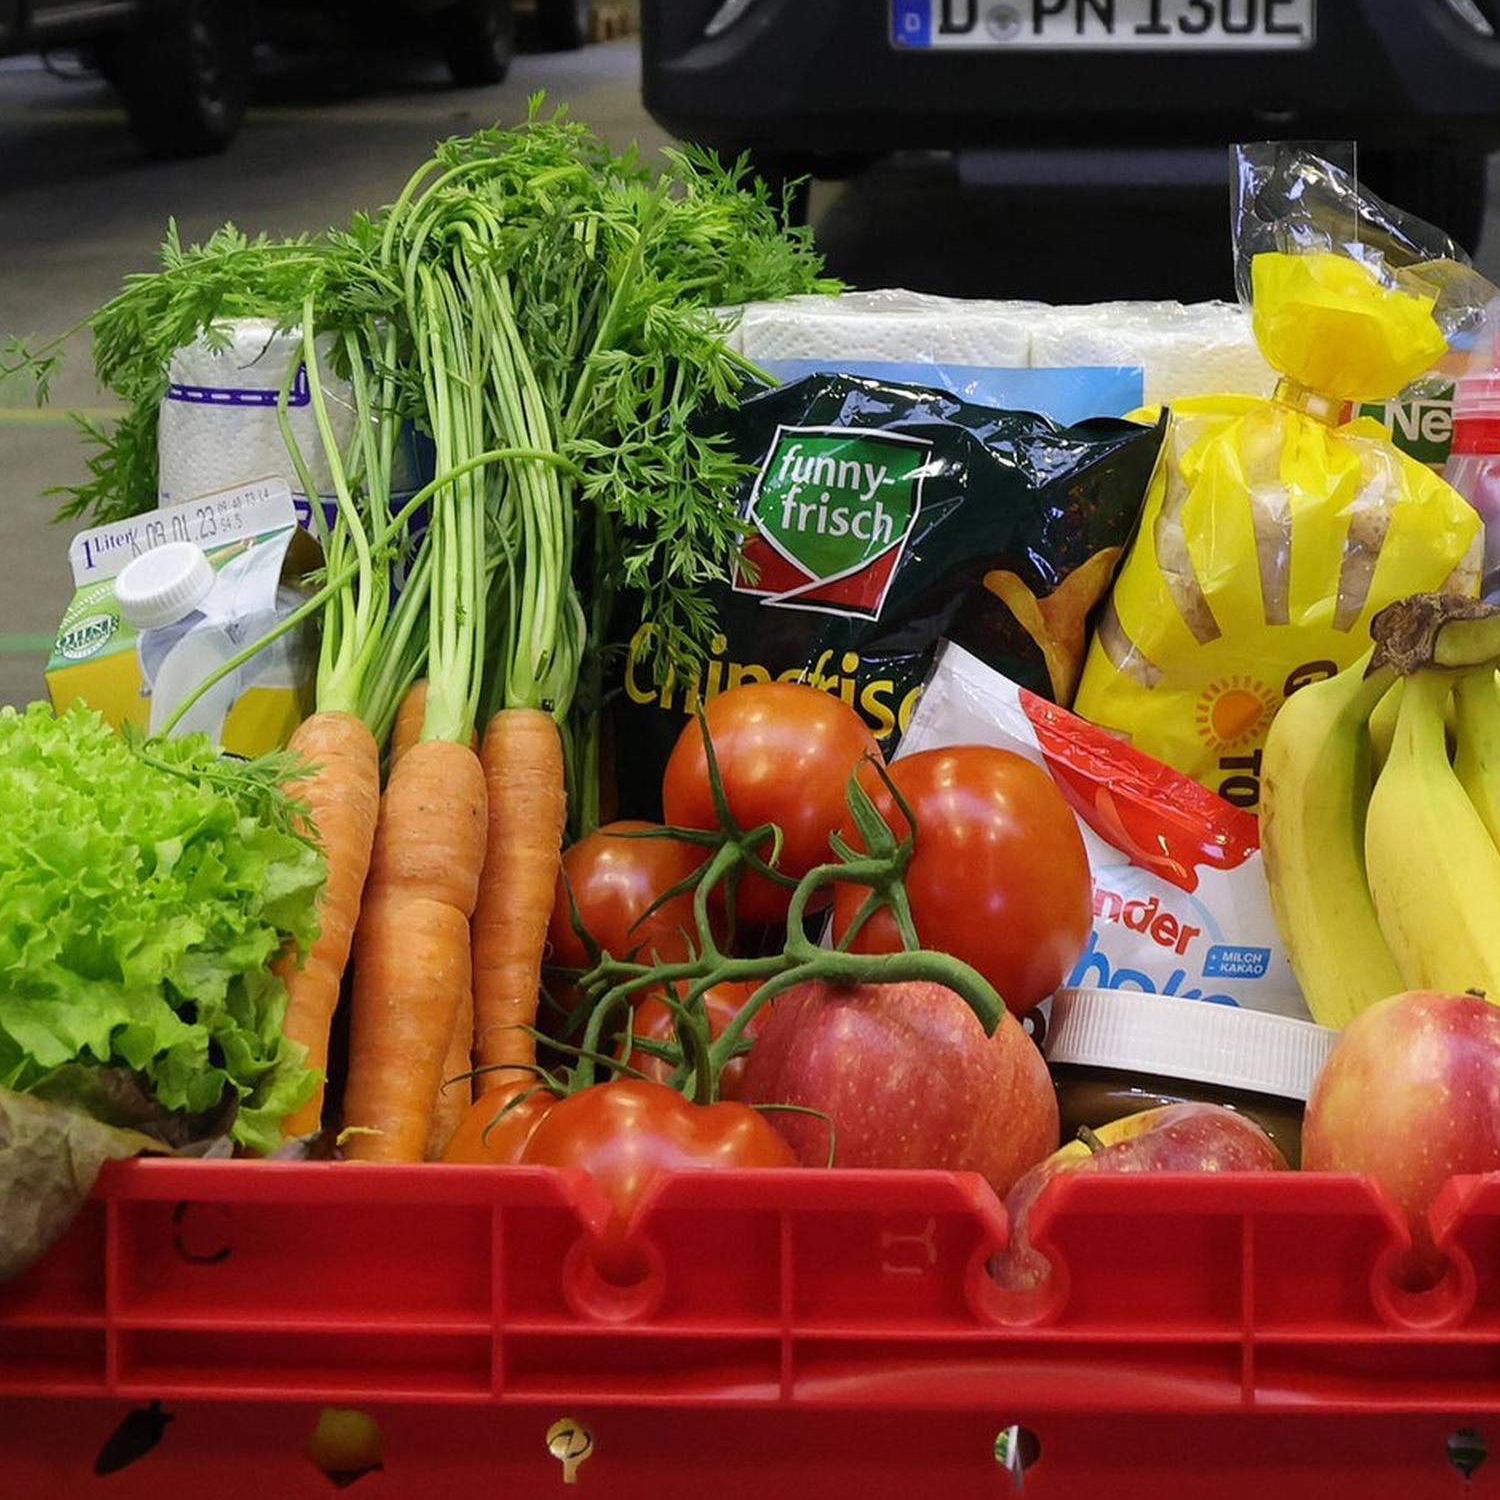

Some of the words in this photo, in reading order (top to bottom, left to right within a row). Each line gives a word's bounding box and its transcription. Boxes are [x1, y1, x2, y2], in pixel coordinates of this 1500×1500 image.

[904, 12, 921, 32] D
[778, 443, 896, 501] funny-
[780, 484, 894, 545] frisch
[82, 539, 96, 570] 1
[94, 530, 132, 553] Liter
[1092, 886, 1201, 956] nder
[1220, 963, 1264, 975] KAKAO
